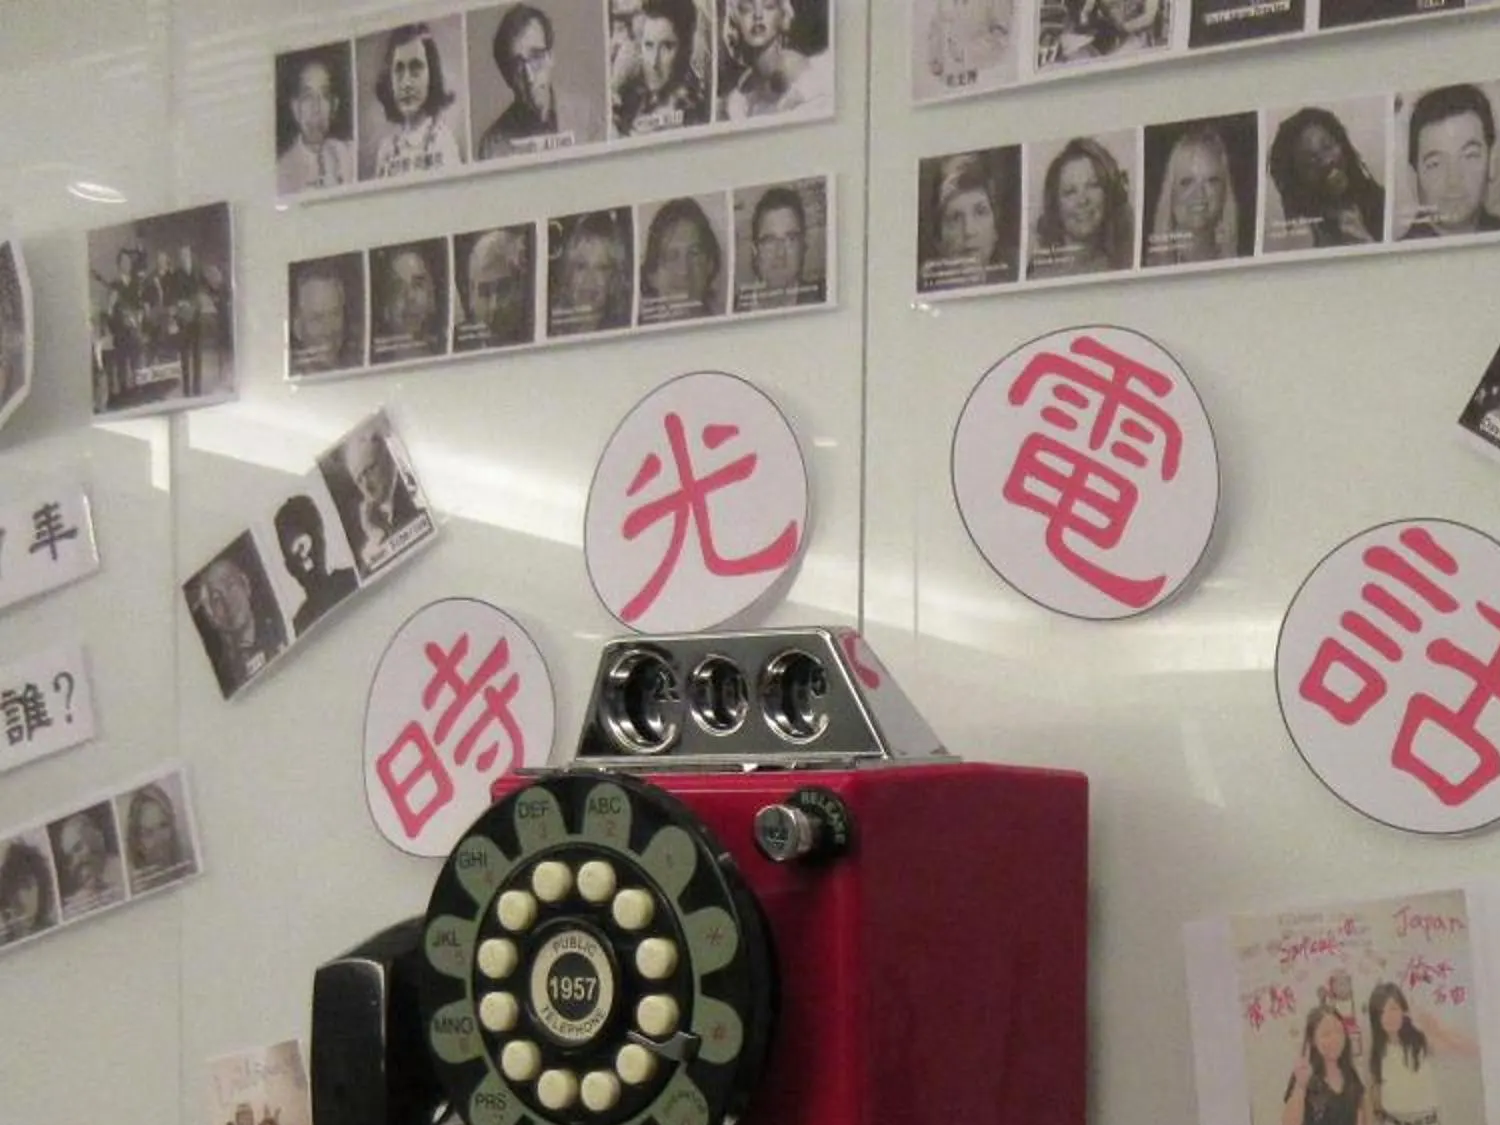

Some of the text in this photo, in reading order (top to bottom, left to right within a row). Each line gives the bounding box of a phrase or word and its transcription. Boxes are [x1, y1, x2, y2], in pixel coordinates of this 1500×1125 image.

[1003, 337, 1183, 608] 電
[0, 503, 78, 561] 年
[622, 416, 797, 621] 光
[376, 634, 526, 839] 時
[518, 800, 552, 820] DEF
[588, 795, 621, 816] ABC
[459, 851, 488, 870] GHI
[1392, 904, 1467, 943] Japan
[433, 931, 463, 949] JKL
[552, 935, 598, 957] PUBLIC
[550, 974, 598, 1003] 1957
[540, 1005, 608, 1037] TELEPHONE
[475, 1092, 508, 1112] PRS
